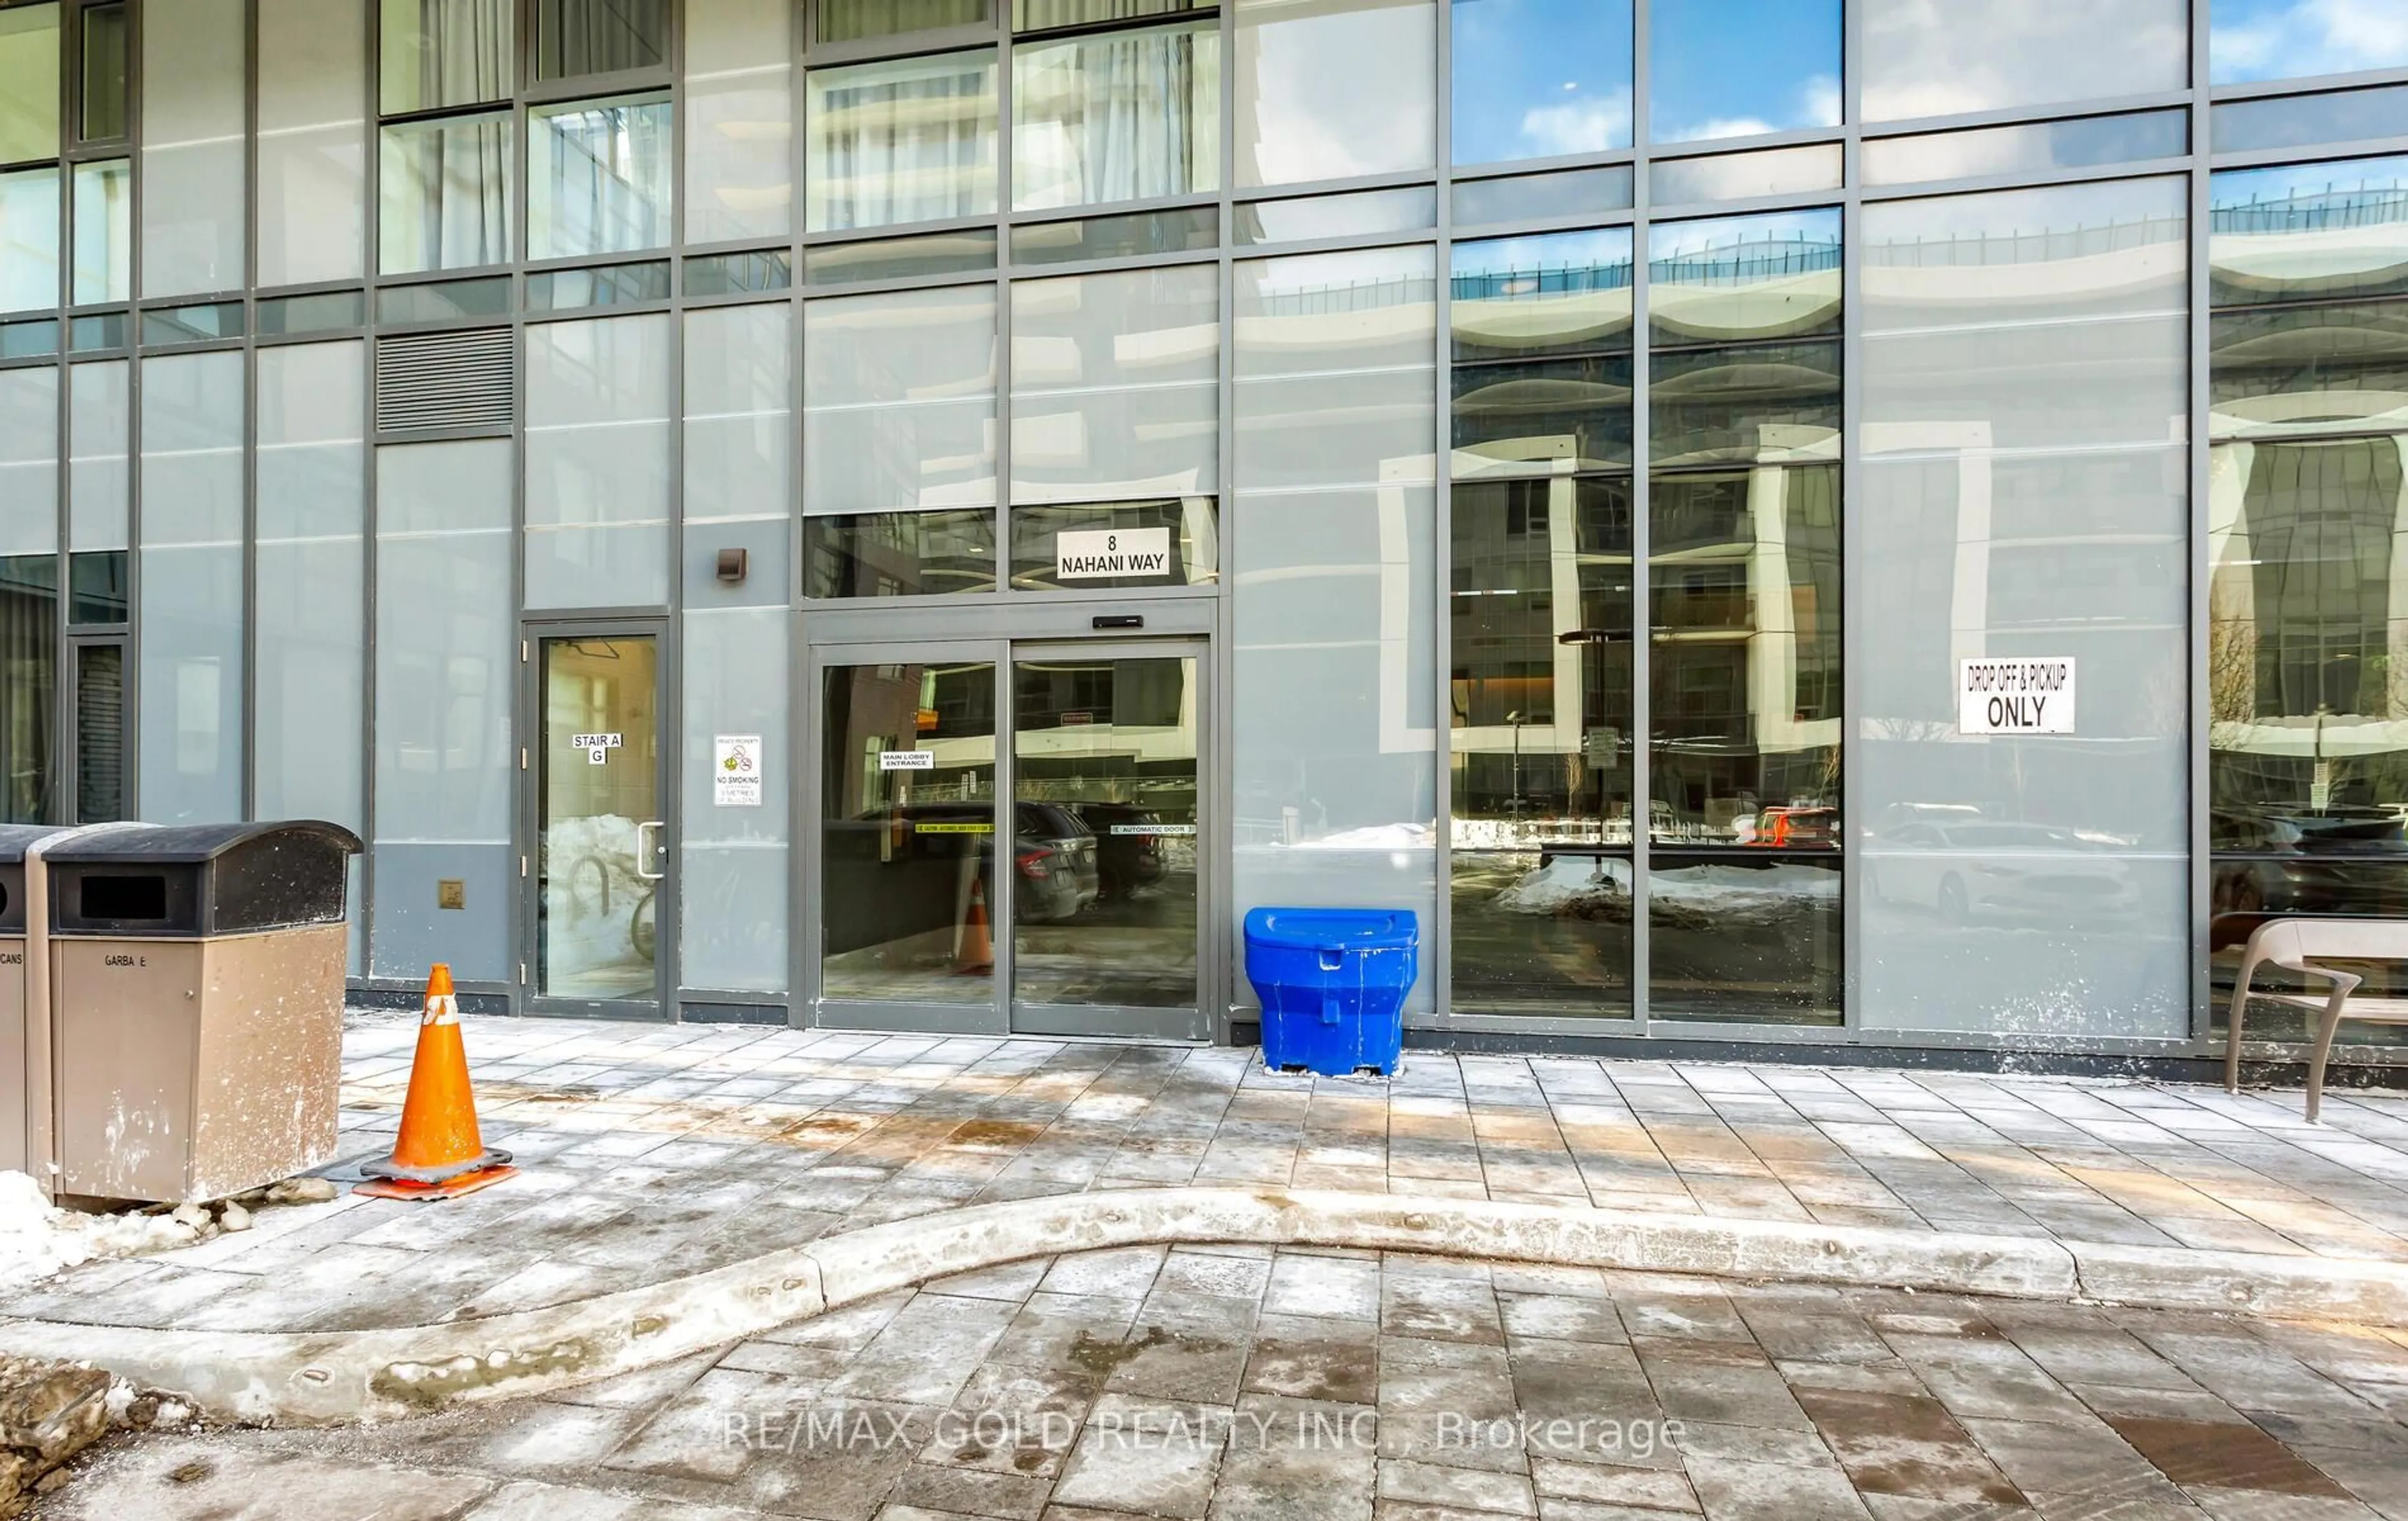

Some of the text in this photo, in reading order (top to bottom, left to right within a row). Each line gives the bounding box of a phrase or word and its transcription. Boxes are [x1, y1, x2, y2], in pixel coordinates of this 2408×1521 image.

[1108, 536, 1116, 551] 8
[1062, 554, 1164, 573] NAHANI WAY
[1968, 664, 2066, 691] DROP OFF & PICKUP
[1988, 696, 2046, 728] ONLY
[575, 735, 620, 746] STAIR A
[593, 750, 602, 761] G
[0, 953, 22, 965] CANS
[105, 955, 147, 967] GARBAE
